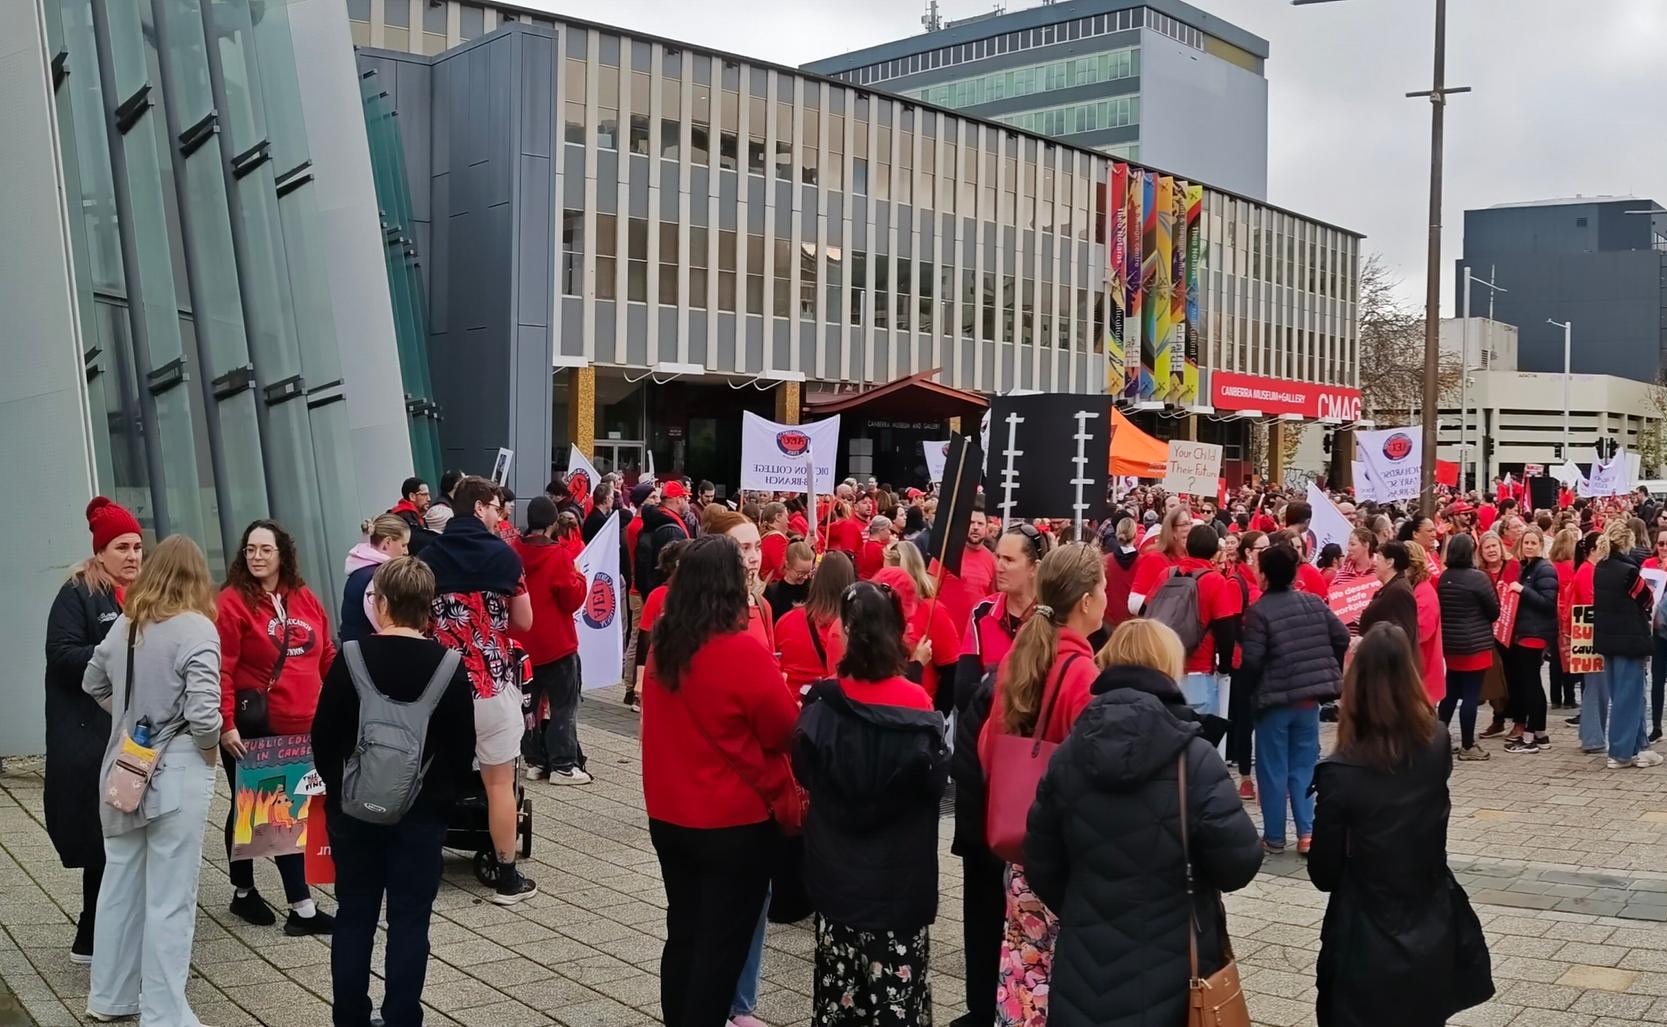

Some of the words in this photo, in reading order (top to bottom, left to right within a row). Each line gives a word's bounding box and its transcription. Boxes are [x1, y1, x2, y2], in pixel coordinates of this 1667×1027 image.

[1191, 226, 1199, 246] Theo
[1191, 247, 1199, 280] Notaras
[1221, 385, 1253, 398] CANBERRA
[1318, 393, 1361, 420] CMAG
[1175, 446, 1191, 458] Your
[1193, 448, 1216, 461] Child
[1170, 461, 1193, 474] Their
[1329, 590, 1344, 601] We
[1346, 591, 1367, 603] safe
[1573, 606, 1594, 624] TE
[1572, 625, 1592, 640] BU
[1571, 657, 1604, 672] TUR
[243, 737, 283, 751] PUBLIC
[288, 734, 312, 746] EDU
[256, 751, 269, 761] IN
